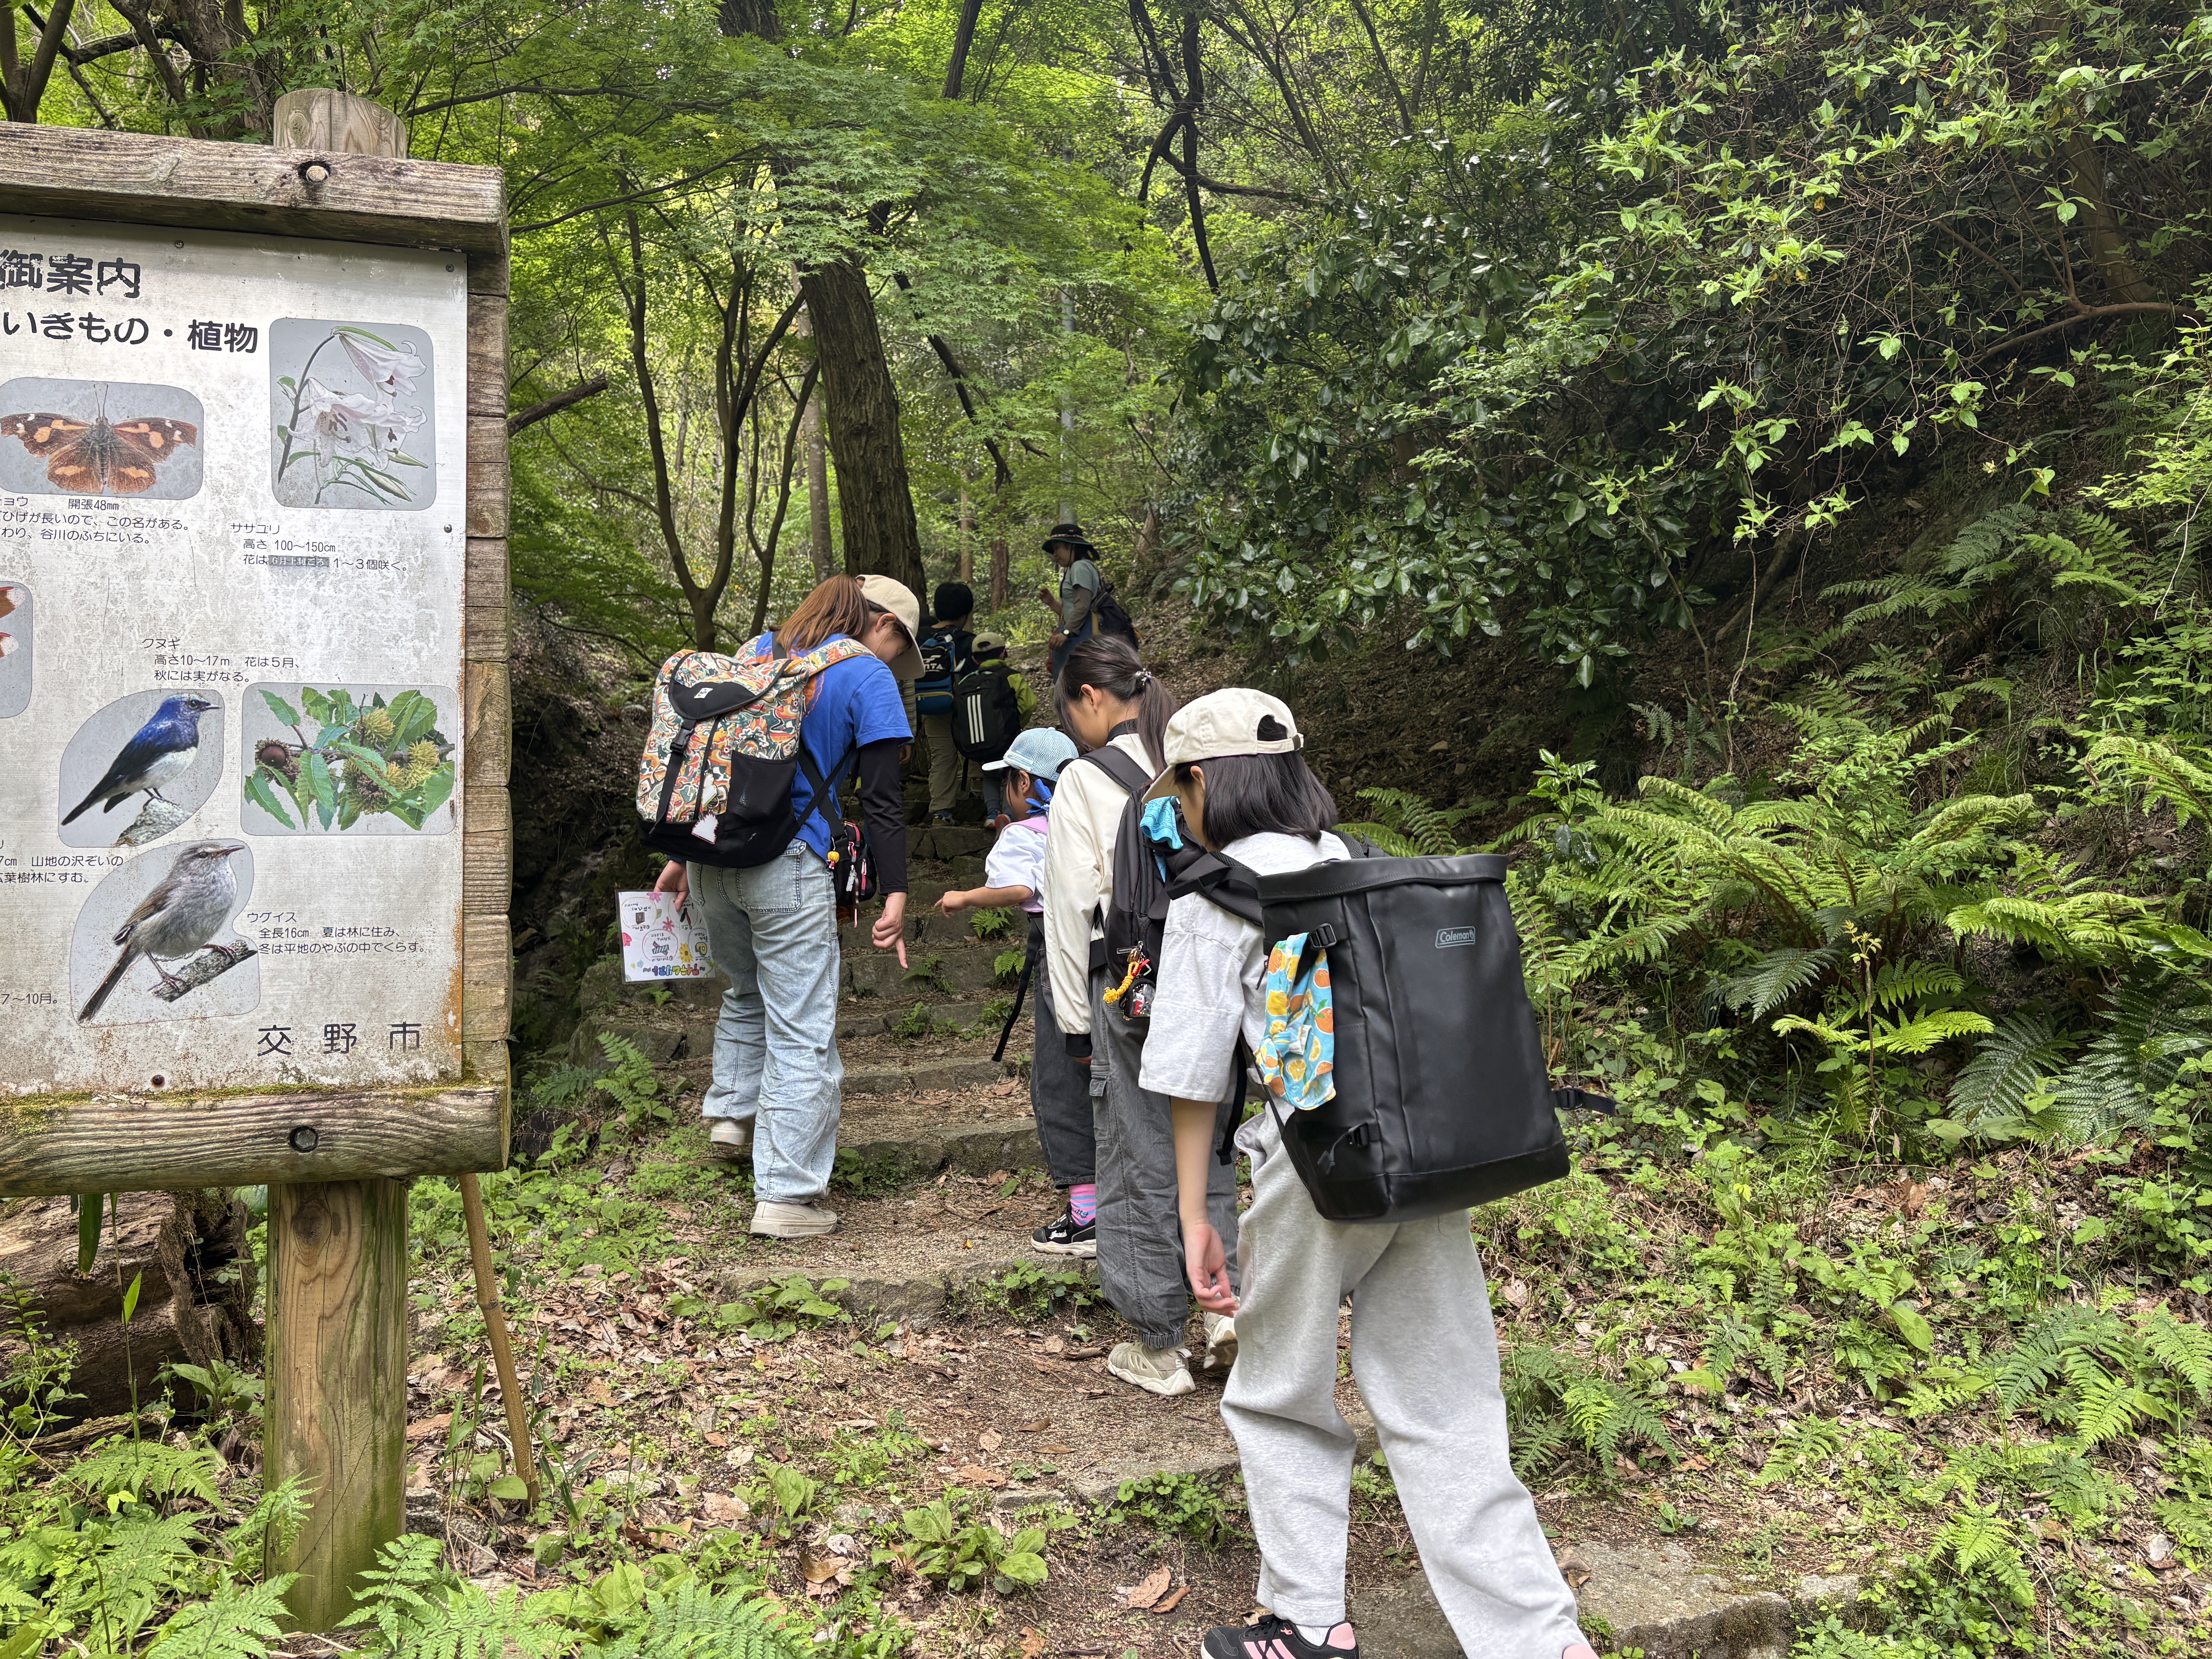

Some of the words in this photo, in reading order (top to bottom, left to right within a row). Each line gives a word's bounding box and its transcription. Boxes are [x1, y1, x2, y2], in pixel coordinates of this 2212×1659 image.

[0, 249, 141, 298] 御案内
[3, 312, 258, 353] いきもの・植物
[0, 496, 28, 507] ョウ
[68, 498, 119, 511] 開張48mm
[0, 510, 188, 530] ひげが長いので、この名がある。
[231, 523, 280, 534] ササユリ
[2, 527, 149, 544] わり、谷川のふちにいる。
[142, 638, 180, 650] クヌギ
[154, 670, 250, 682] 秋には実がなる。
[32, 855, 124, 867] 山地の沢ぞいの
[247, 912, 297, 923] ウグイス
[259, 927, 309, 938] 全長16cm
[1440, 930, 1469, 943] Coleman
[258, 942, 425, 955] 冬は平地のやぶの中でくらす。
